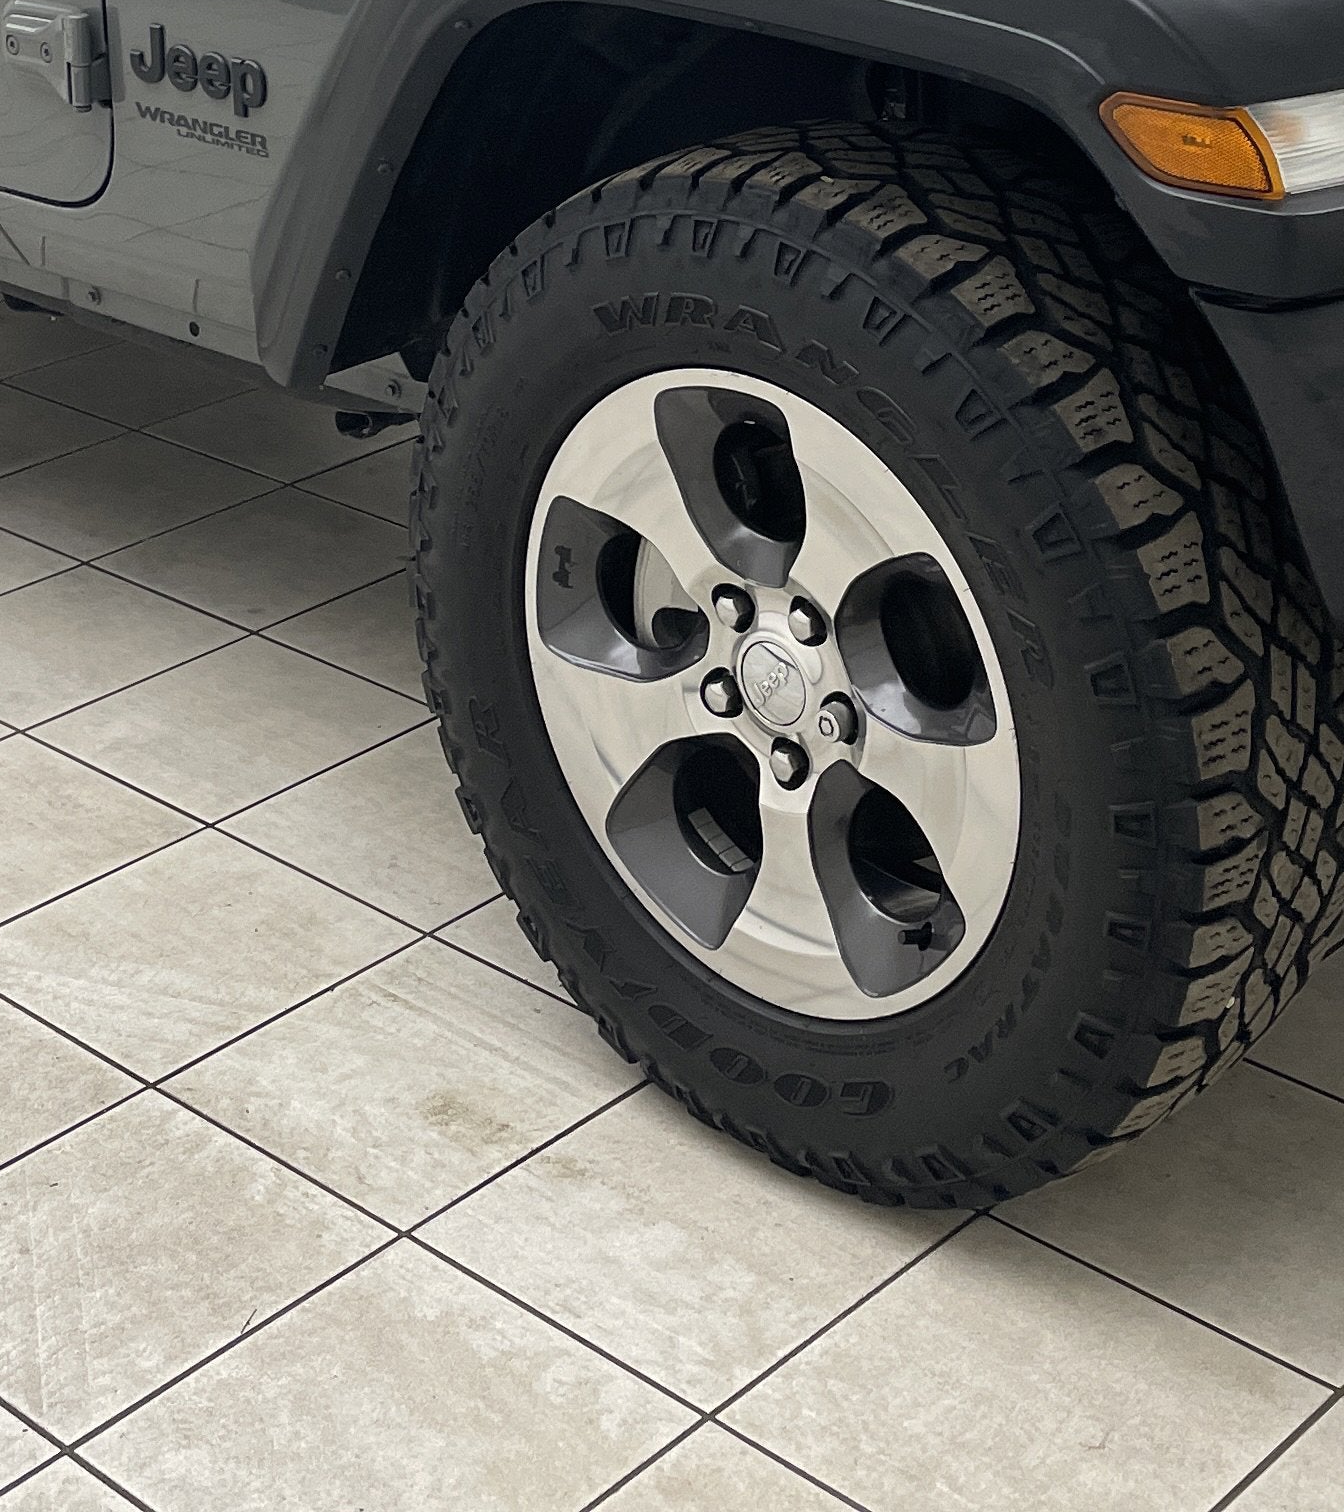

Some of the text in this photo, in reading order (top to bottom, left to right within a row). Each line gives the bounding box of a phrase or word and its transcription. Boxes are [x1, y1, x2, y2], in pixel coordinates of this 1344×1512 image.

[129, 22, 268, 118] Jeep
[135, 101, 269, 150] WRANGLER
[176, 129, 270, 158] UNLIMITED
[591, 290, 1055, 689] WRANGLER
[754, 661, 790, 707] Jeep
[468, 694, 896, 1117] GOODYEAR
